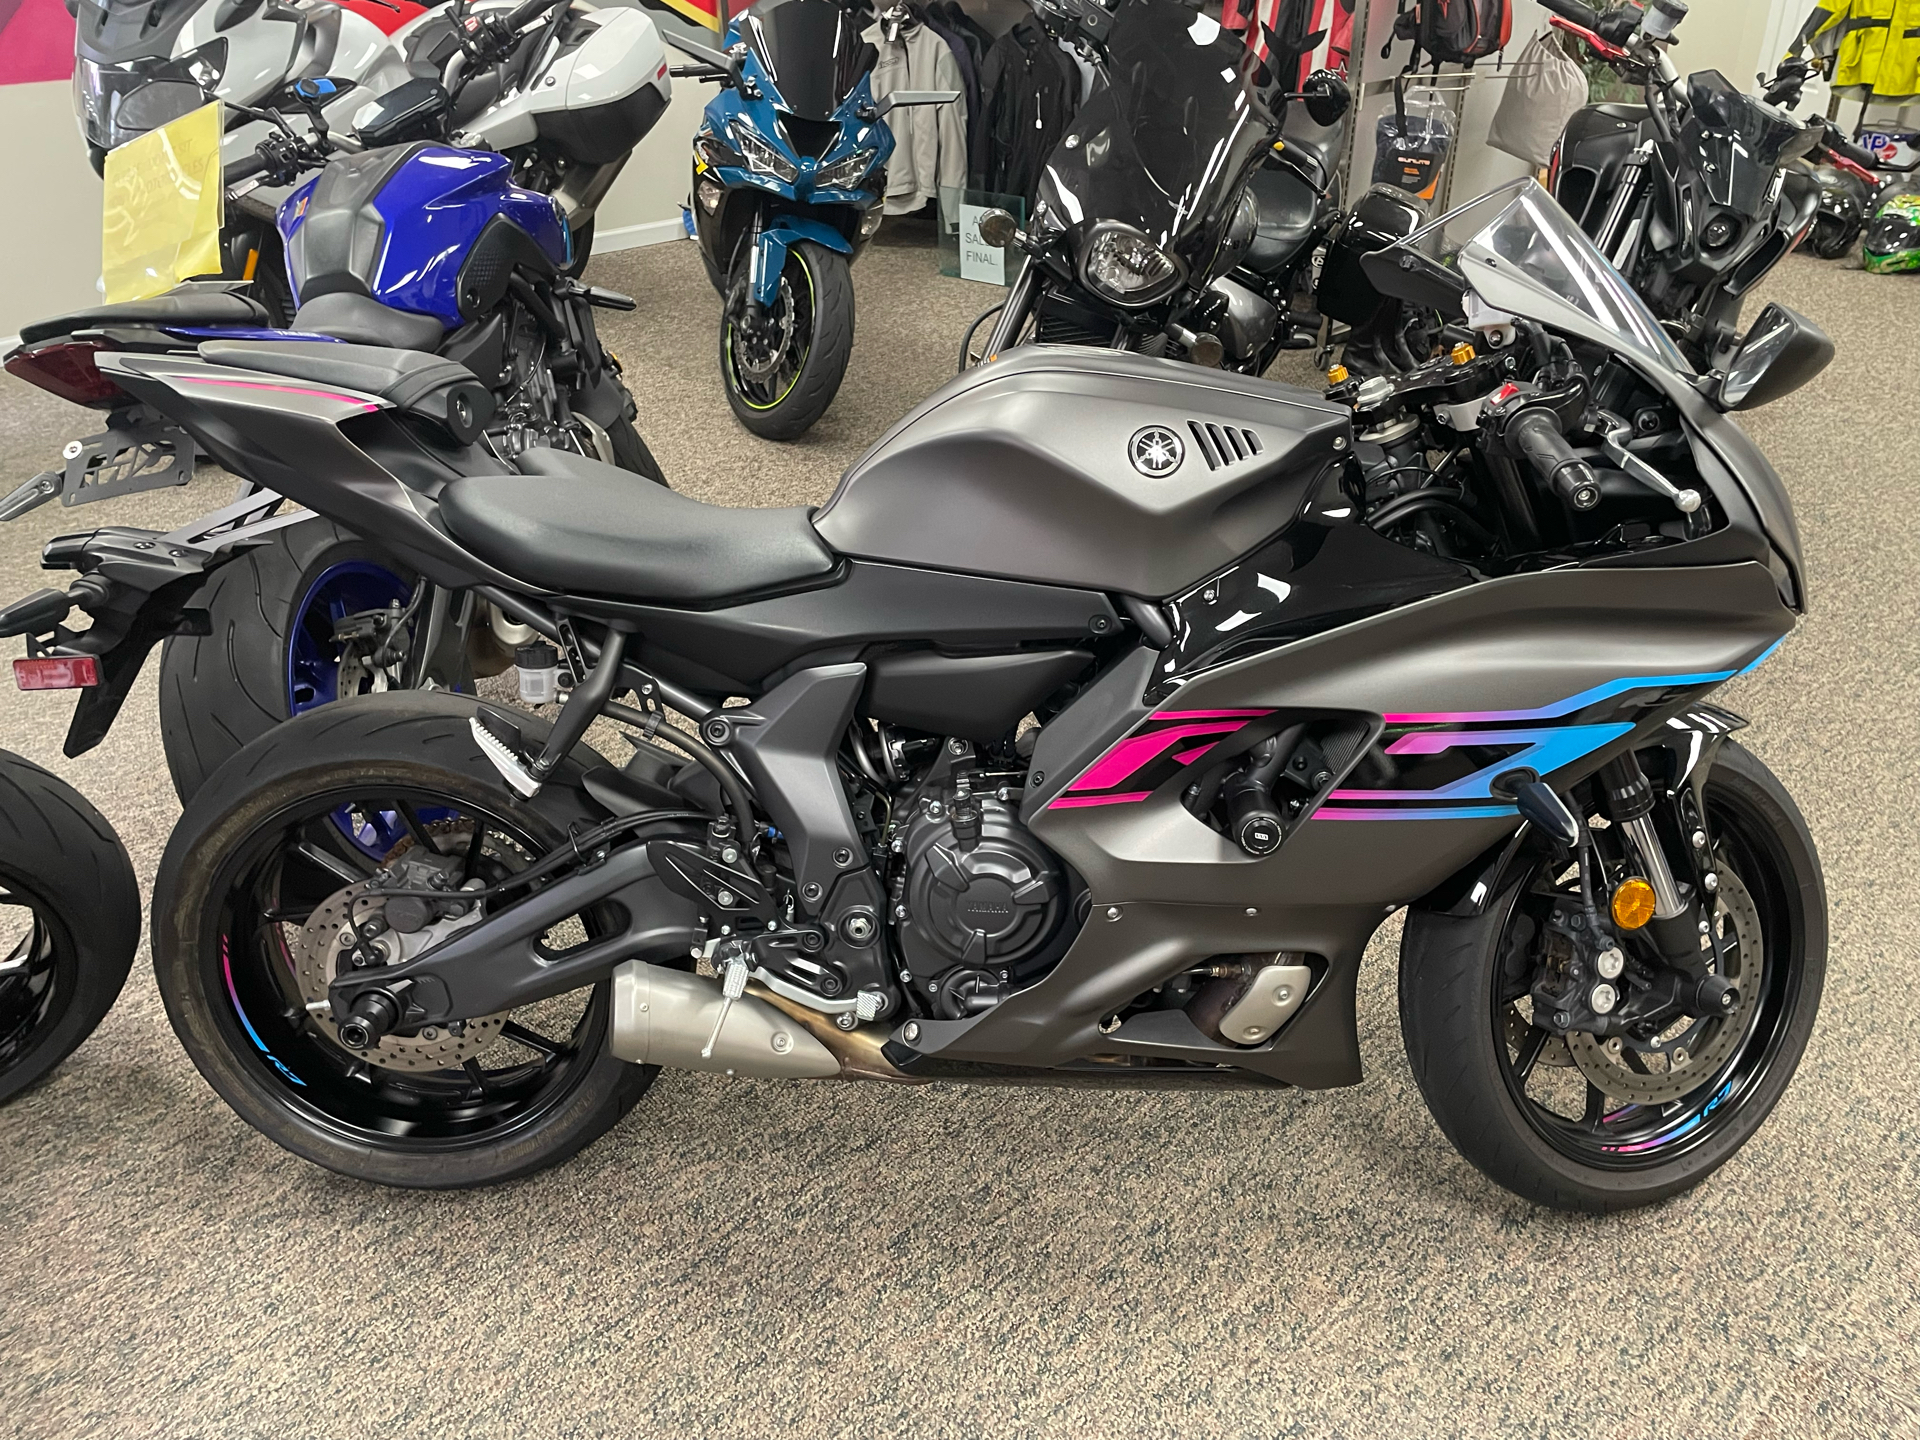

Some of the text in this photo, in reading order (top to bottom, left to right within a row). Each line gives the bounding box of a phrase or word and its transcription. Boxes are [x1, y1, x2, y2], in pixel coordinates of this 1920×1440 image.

[965, 232, 992, 247] SAL
[967, 900, 1009, 914] YAMAHA
[1703, 1080, 1733, 1117] R7
